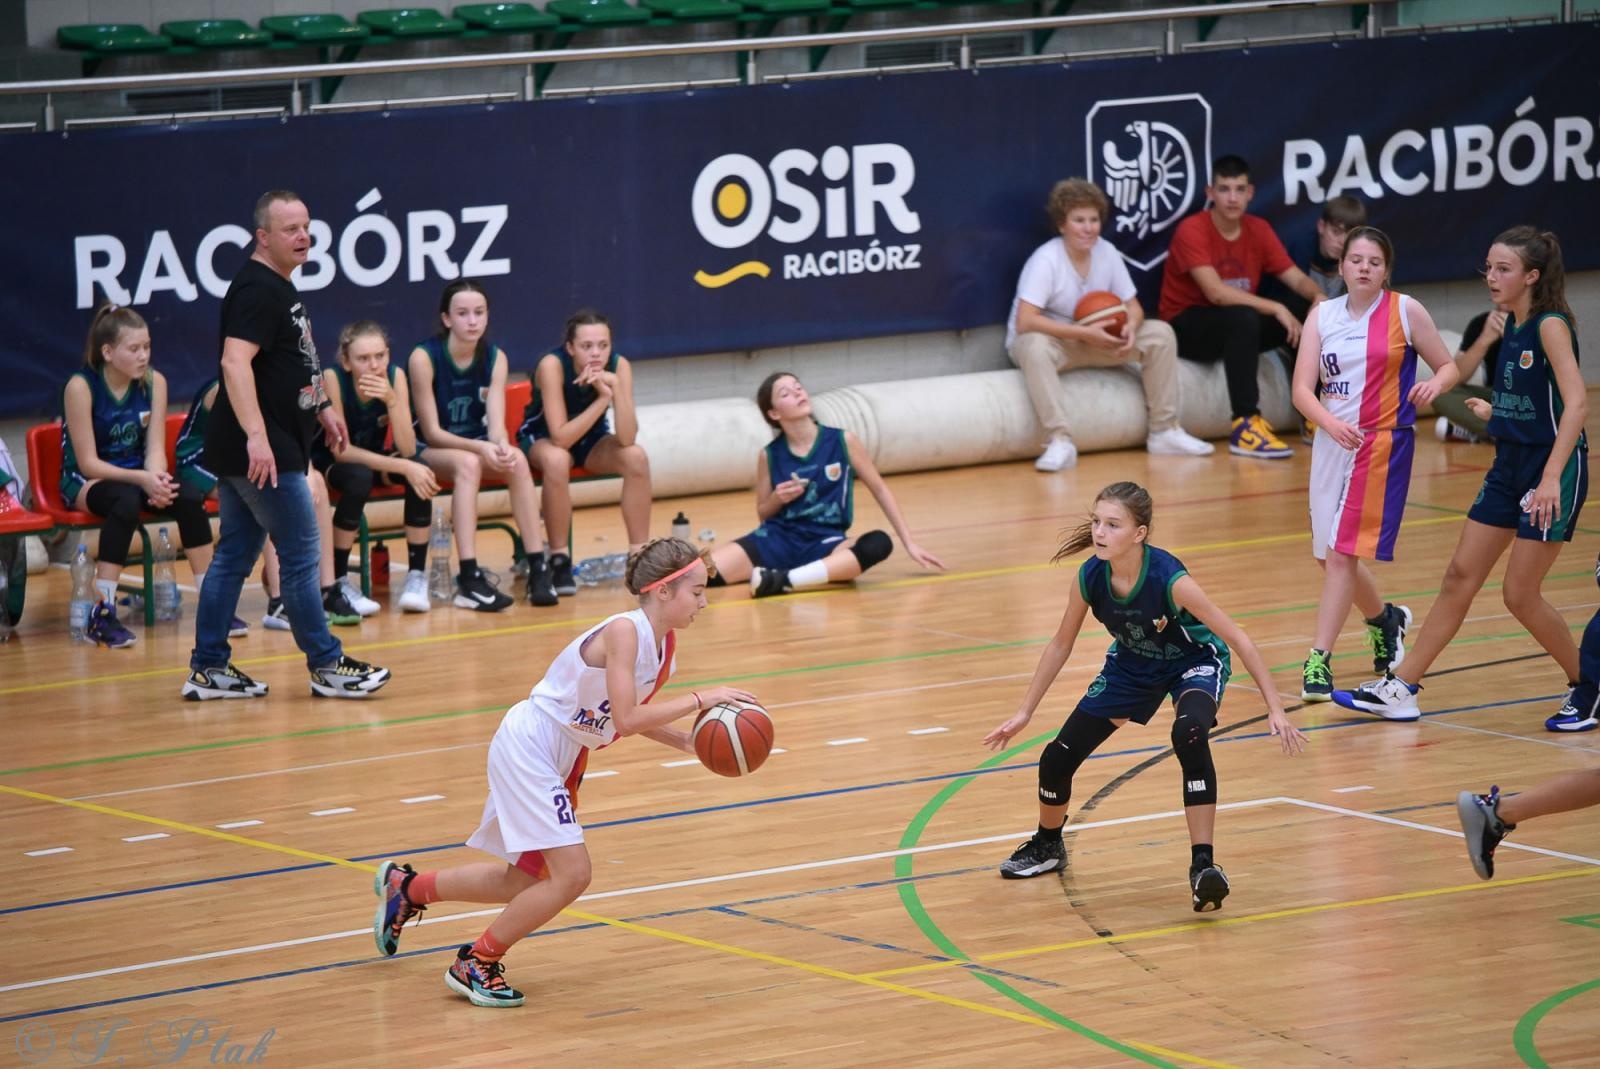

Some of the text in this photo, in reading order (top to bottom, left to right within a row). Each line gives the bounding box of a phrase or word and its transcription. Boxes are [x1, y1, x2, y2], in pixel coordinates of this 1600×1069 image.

[1282, 96, 1600, 205] RACIBÓR
[74, 187, 511, 309] RACBÓRZ
[783, 239, 922, 280] RACIBÓRZ
[1503, 361, 1515, 390] 5
[447, 396, 473, 422] 17
[1044, 790, 1057, 799] NBA
[1192, 780, 1206, 791] NBA
